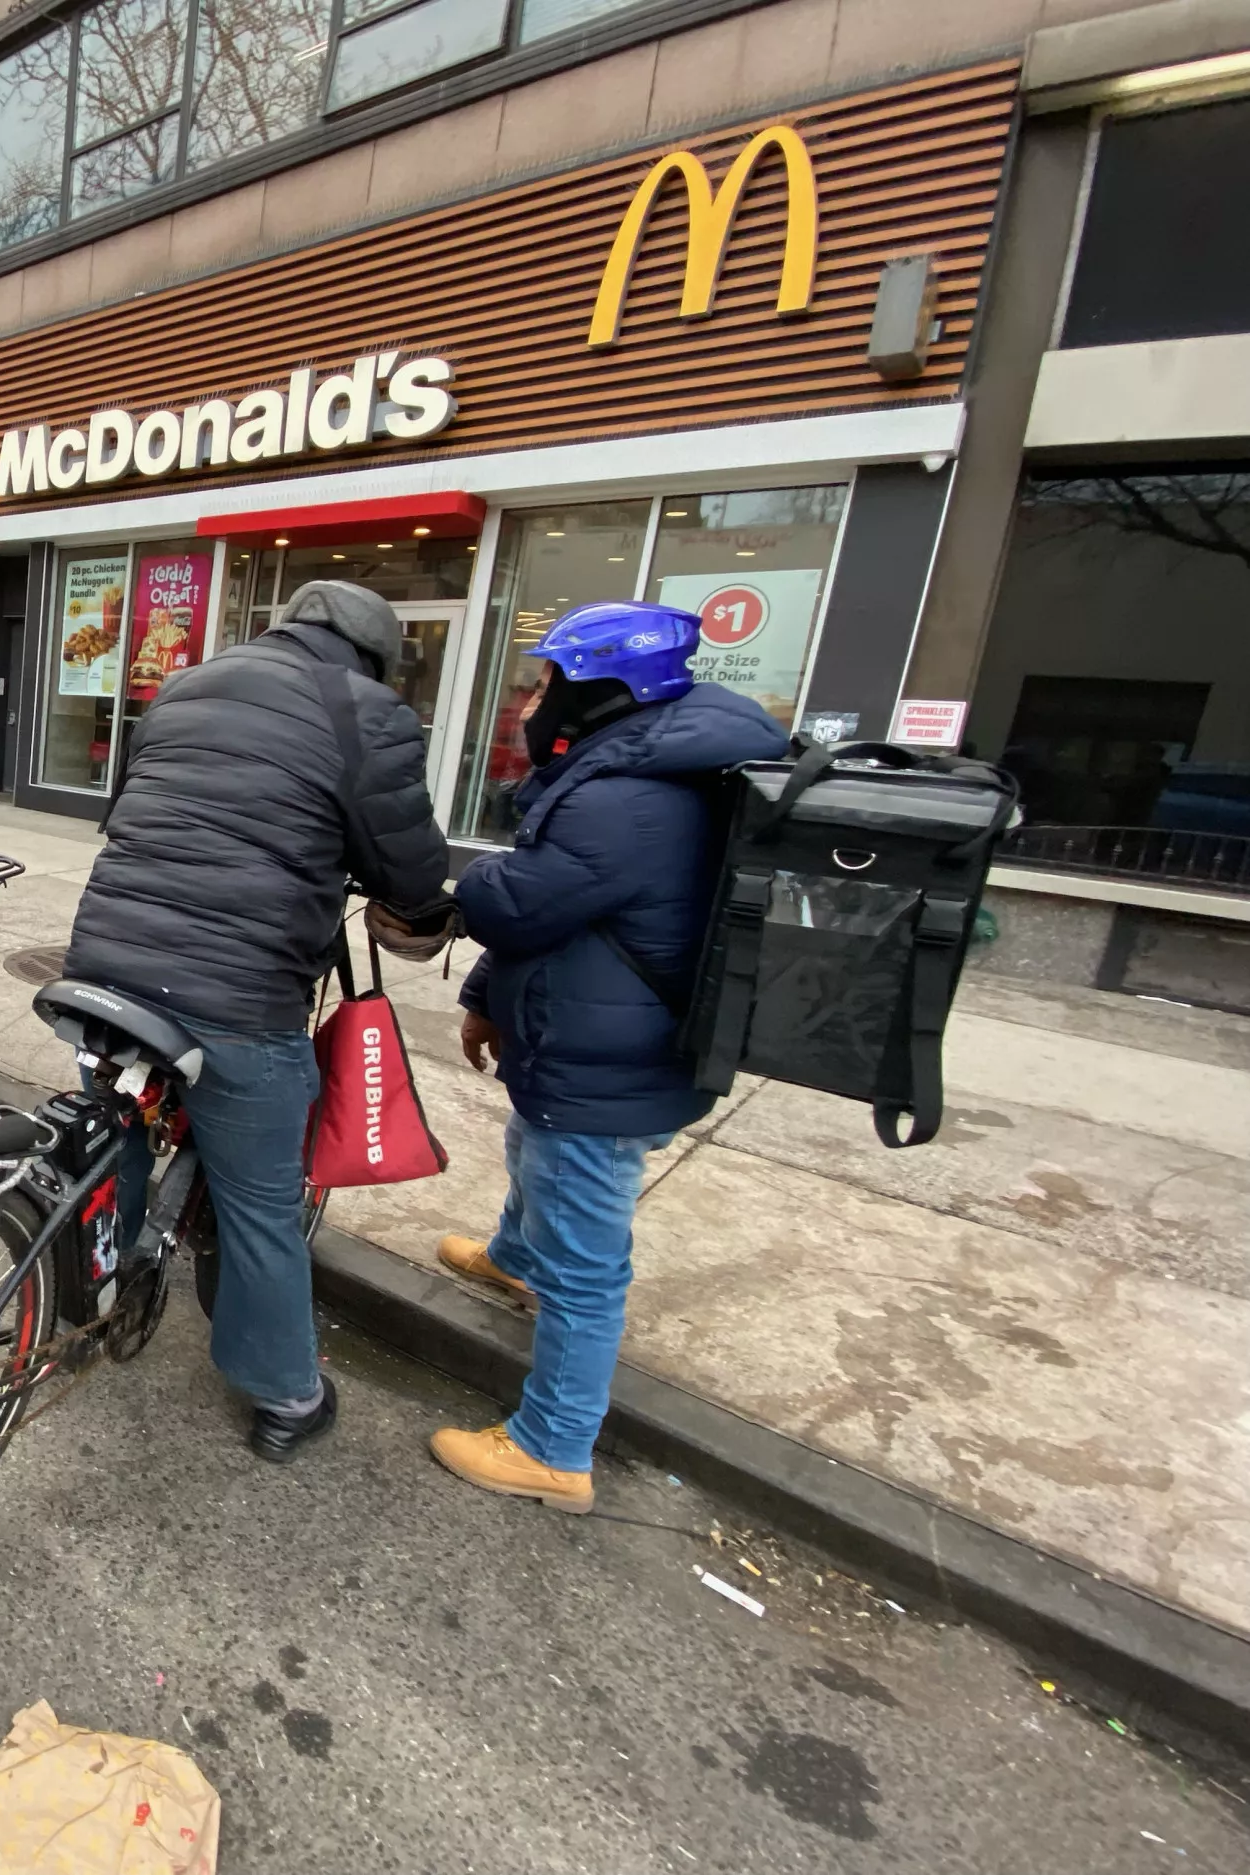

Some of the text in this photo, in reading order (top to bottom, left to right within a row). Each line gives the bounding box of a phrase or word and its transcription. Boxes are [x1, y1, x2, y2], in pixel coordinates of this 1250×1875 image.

[71, 566, 80, 575] 20
[93, 563, 126, 574] Chicken
[70, 576, 114, 587] McNuggets
[70, 589, 96, 598] Bundle
[713, 601, 746, 632] $1
[724, 654, 760, 667] Size
[691, 670, 757, 682] oft Drink
[74, 989, 123, 1012] SCHWINN
[362, 1027, 383, 1165] GRUBHUB
